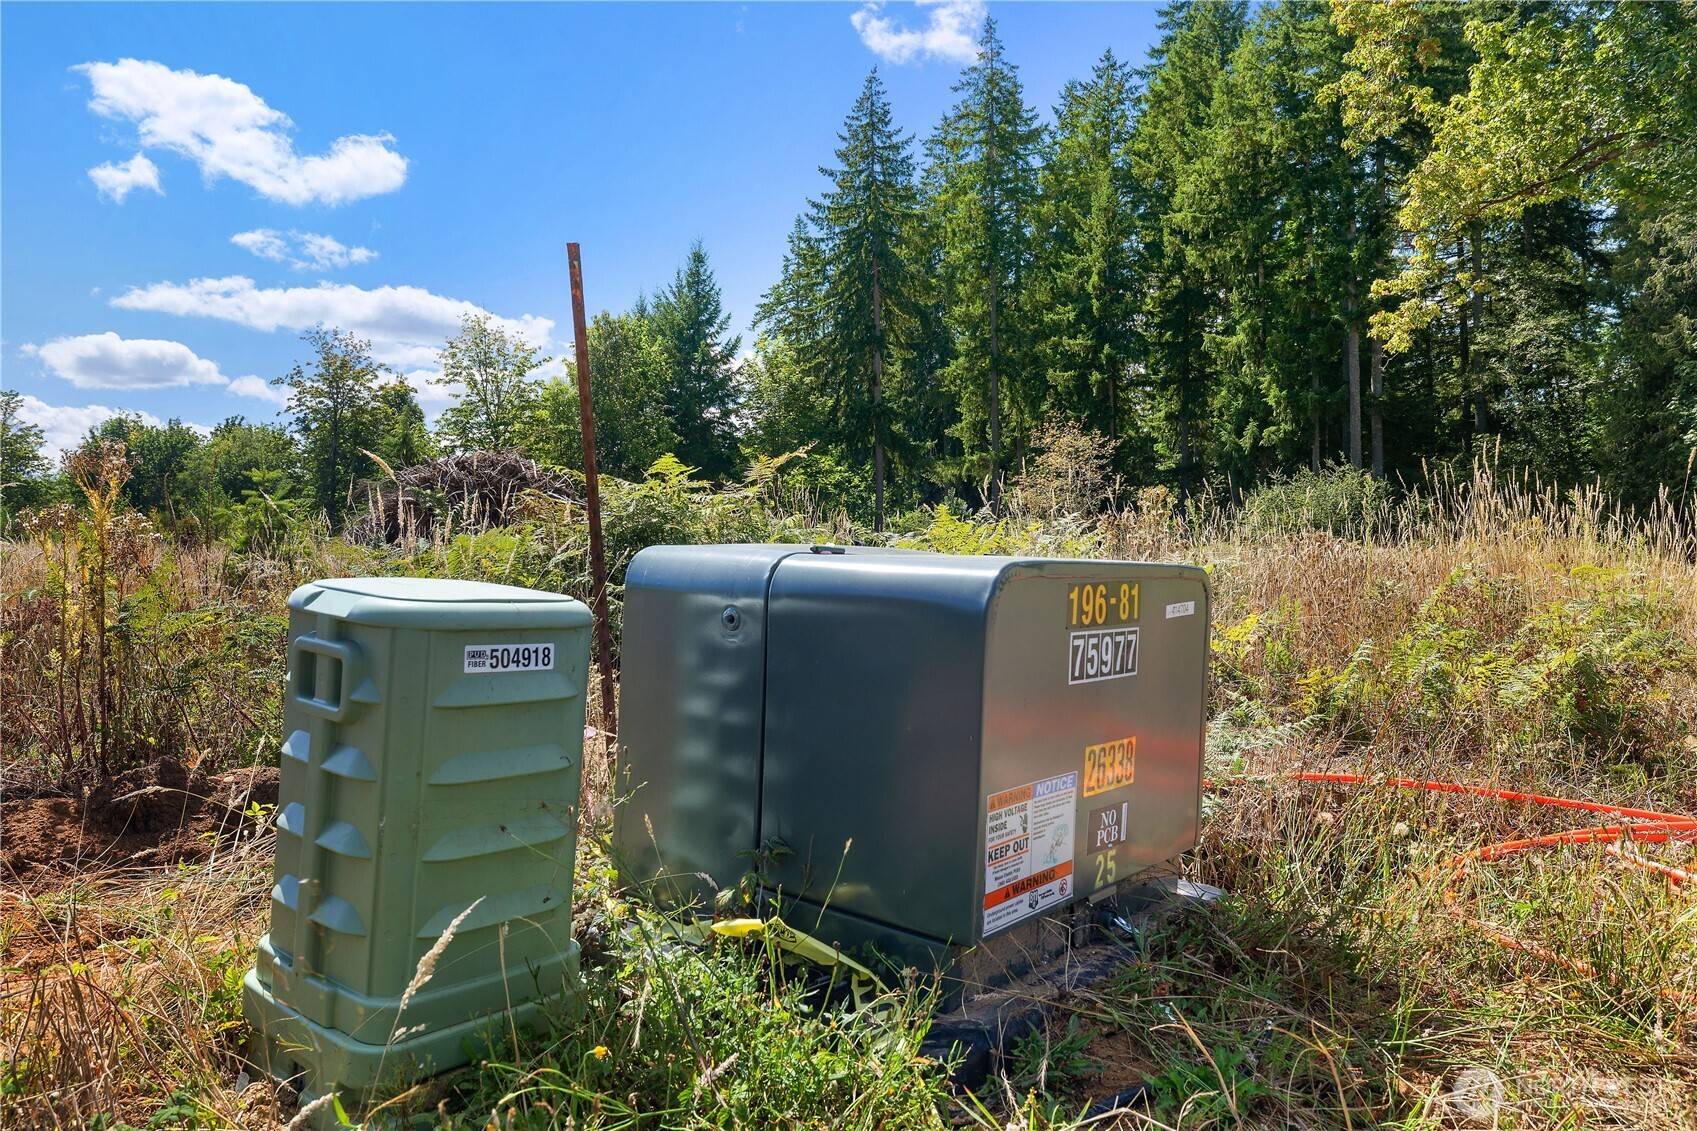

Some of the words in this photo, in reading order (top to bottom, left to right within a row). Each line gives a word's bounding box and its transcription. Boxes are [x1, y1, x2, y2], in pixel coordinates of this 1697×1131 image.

[1070, 583, 1138, 624] 196-81
[467, 660, 486, 668] FIBER
[490, 647, 550, 668] 504918
[1073, 634, 1137, 677] 75977
[1086, 741, 1133, 792] 26338
[1036, 776, 1074, 796] NOTICE
[998, 787, 1031, 806] WARNING
[989, 812, 1002, 823] HIGH
[1003, 803, 1027, 817] VOLTAGE
[1101, 810, 1117, 828] NO
[988, 821, 1007, 834] INSIDE
[1097, 826, 1118, 846] PCB
[988, 844, 1010, 863] KEEP
[1012, 838, 1029, 852] OUT
[1095, 849, 1116, 889] 25
[1012, 869, 1055, 894] WARNING
